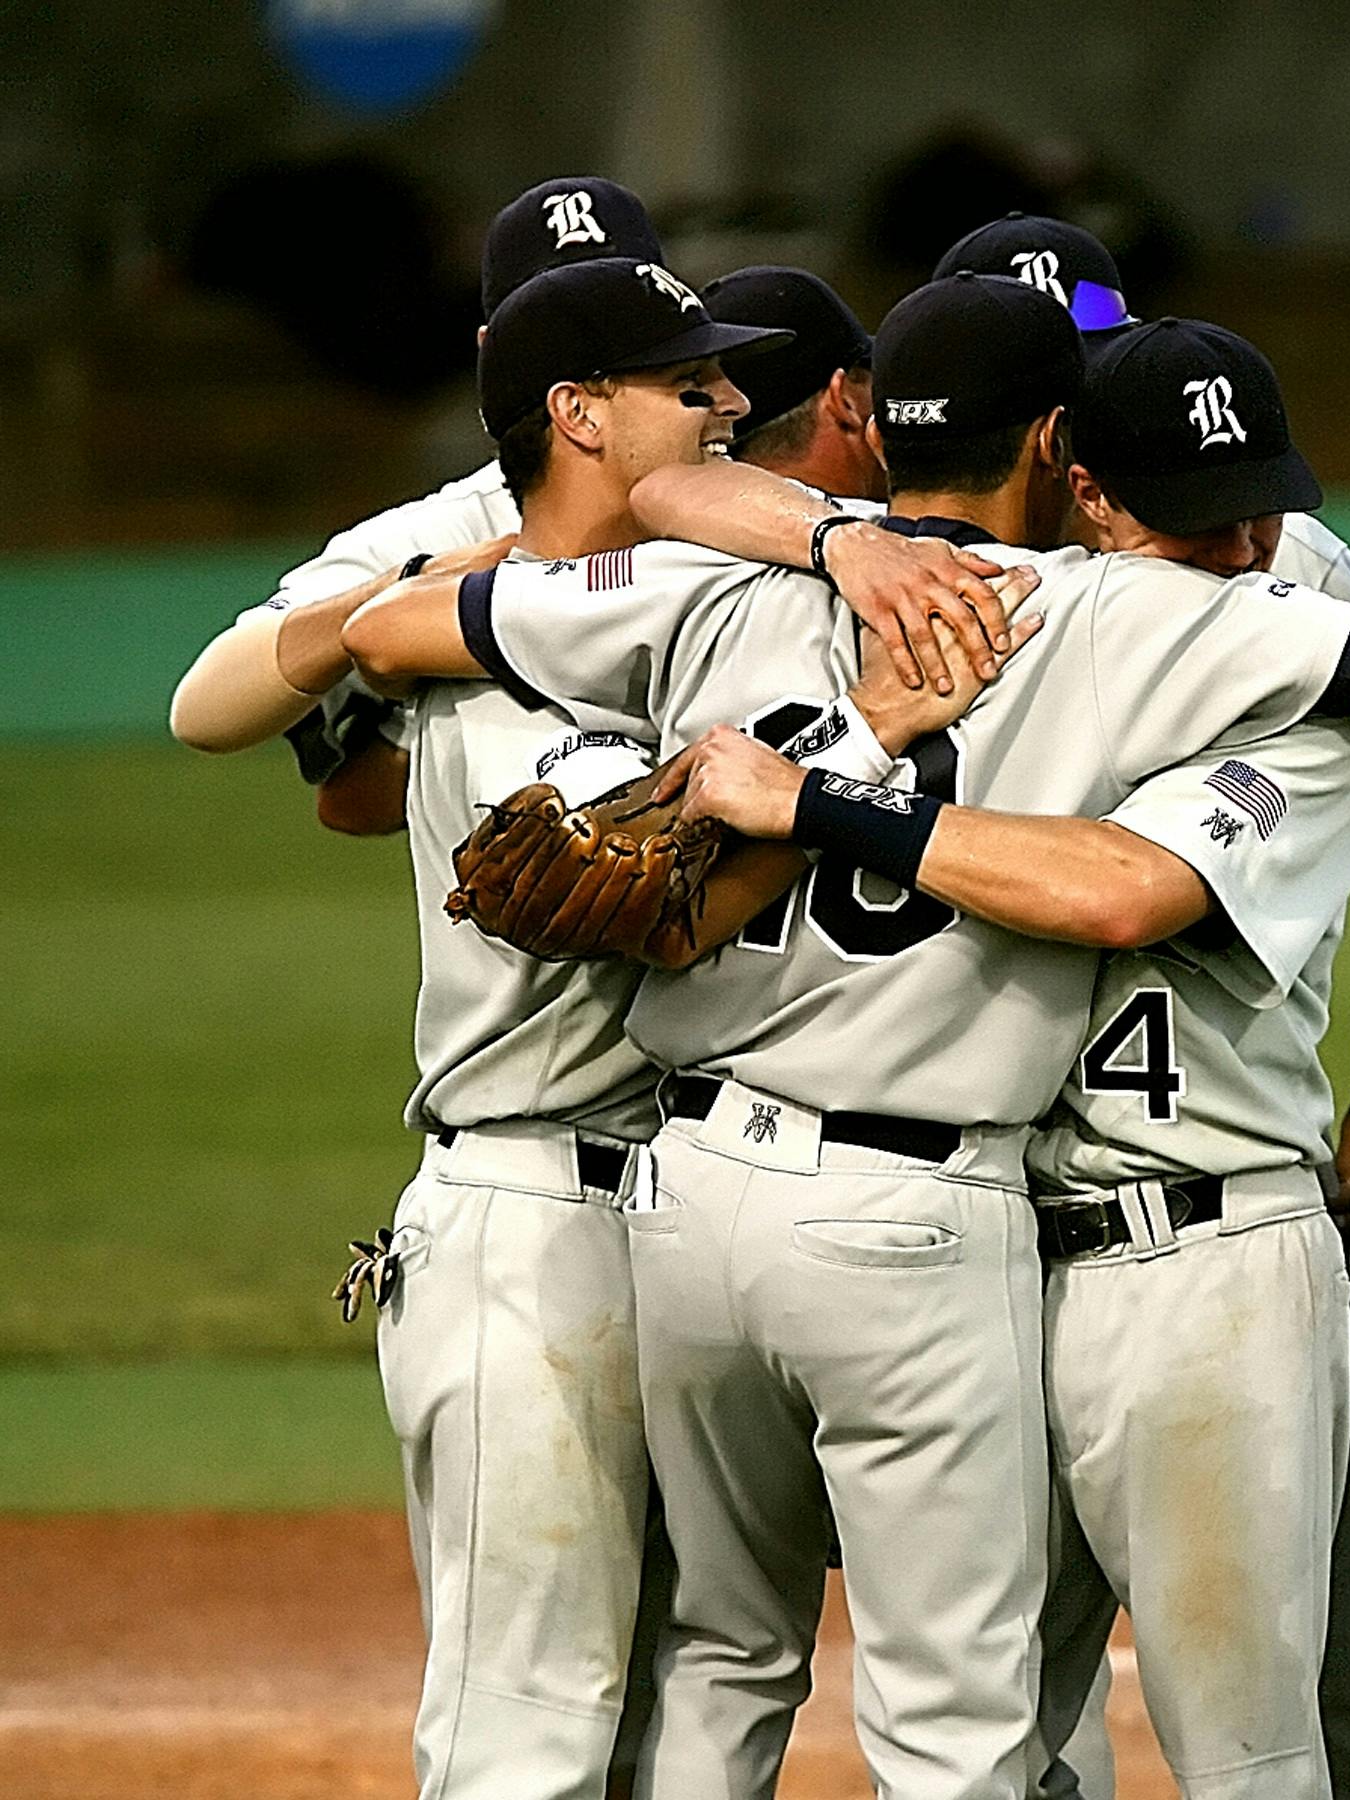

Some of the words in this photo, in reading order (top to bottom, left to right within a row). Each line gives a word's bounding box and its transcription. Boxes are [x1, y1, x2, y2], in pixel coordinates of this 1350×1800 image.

[541, 191, 606, 250] R
[886, 398, 949, 425] TPX
[1183, 376, 1246, 449] R
[820, 771, 925, 815] TPX
[1080, 987, 1187, 1124] 4
